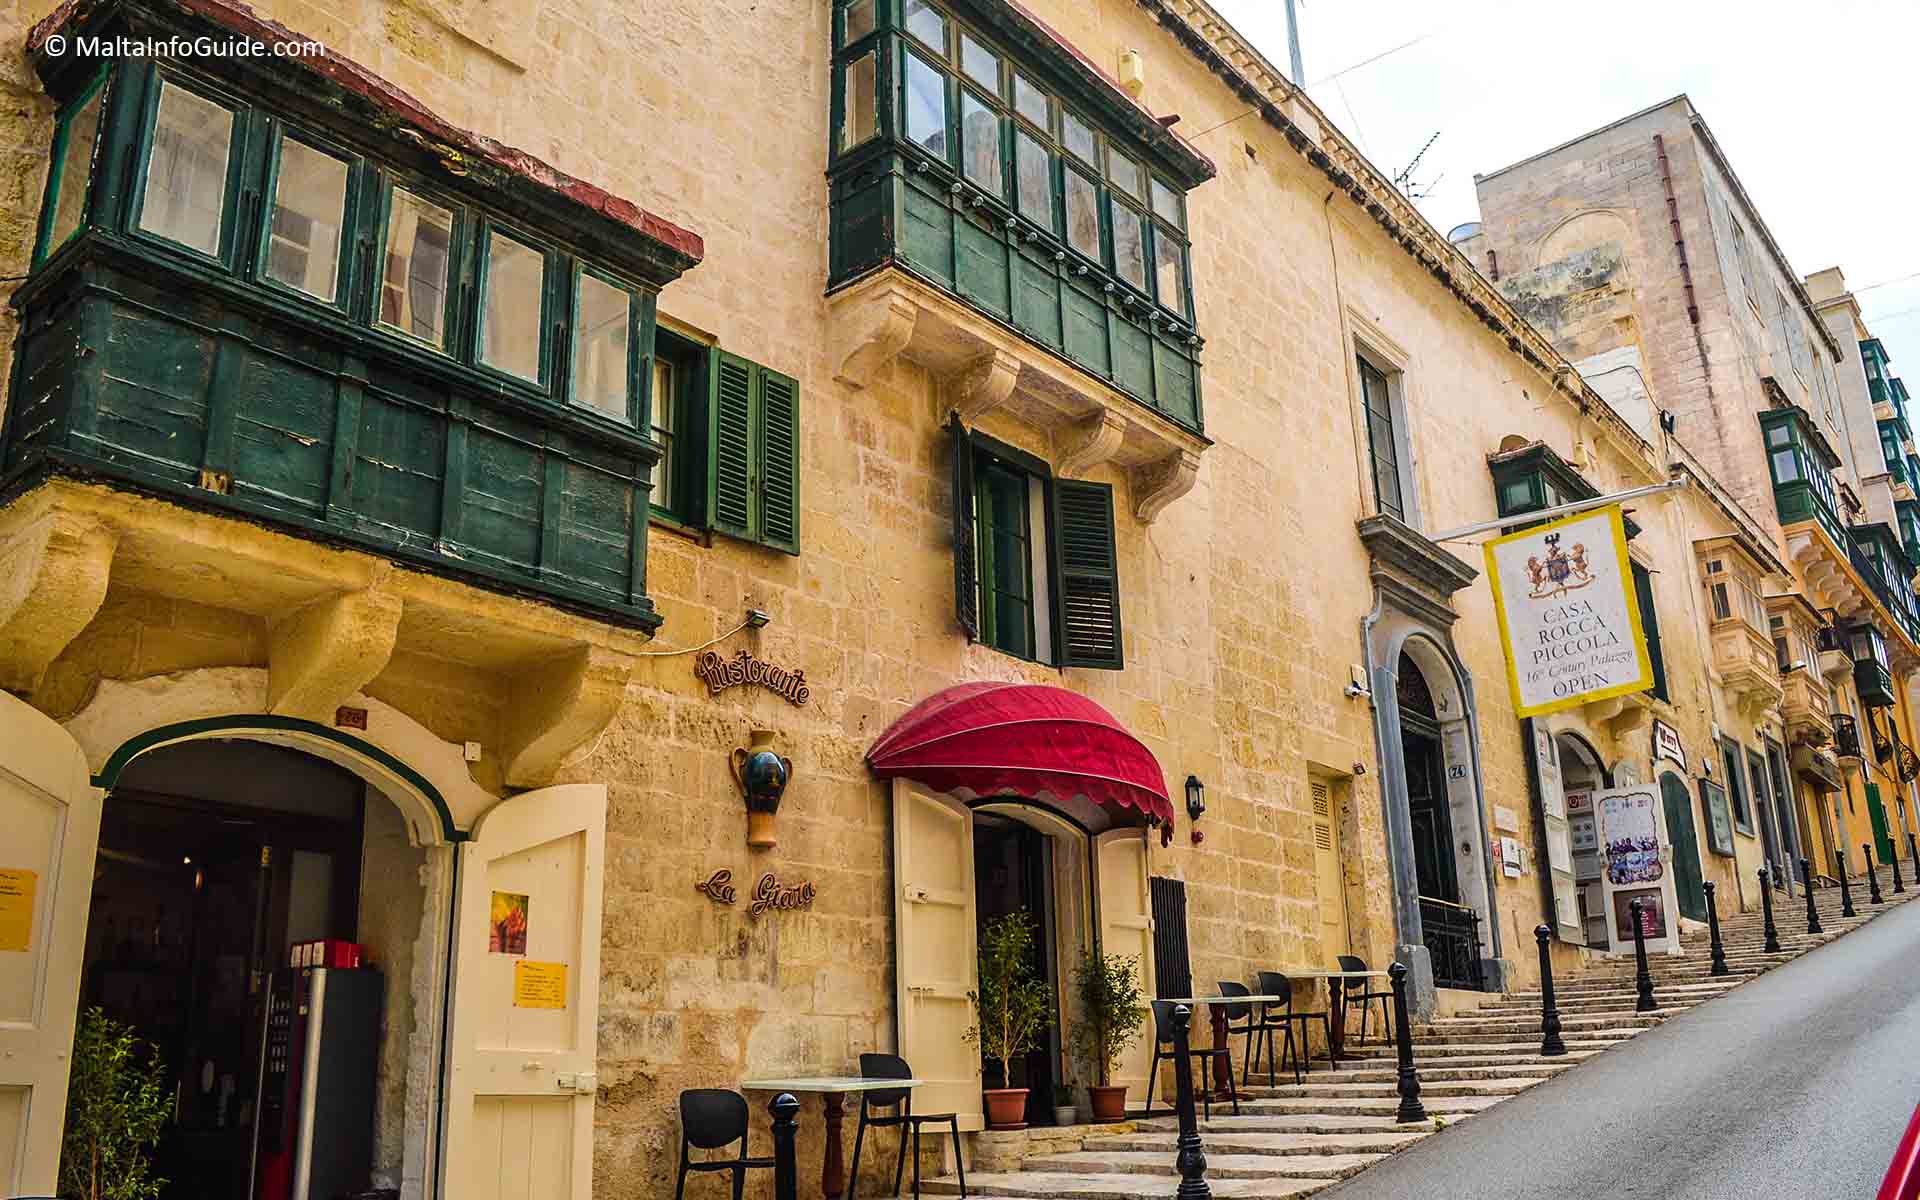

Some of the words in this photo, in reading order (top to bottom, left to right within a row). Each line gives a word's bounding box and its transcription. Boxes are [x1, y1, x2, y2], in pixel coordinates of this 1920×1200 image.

[1543, 599, 1592, 624] CASA
[1538, 615, 1606, 645] ROCCA
[1532, 630, 1620, 665] PICCOLA
[1591, 649, 1634, 666] Palazzo
[695, 648, 811, 707] Ristorante
[1552, 672, 1609, 697] OPEN
[695, 868, 737, 905] La
[751, 872, 816, 916] Giara
